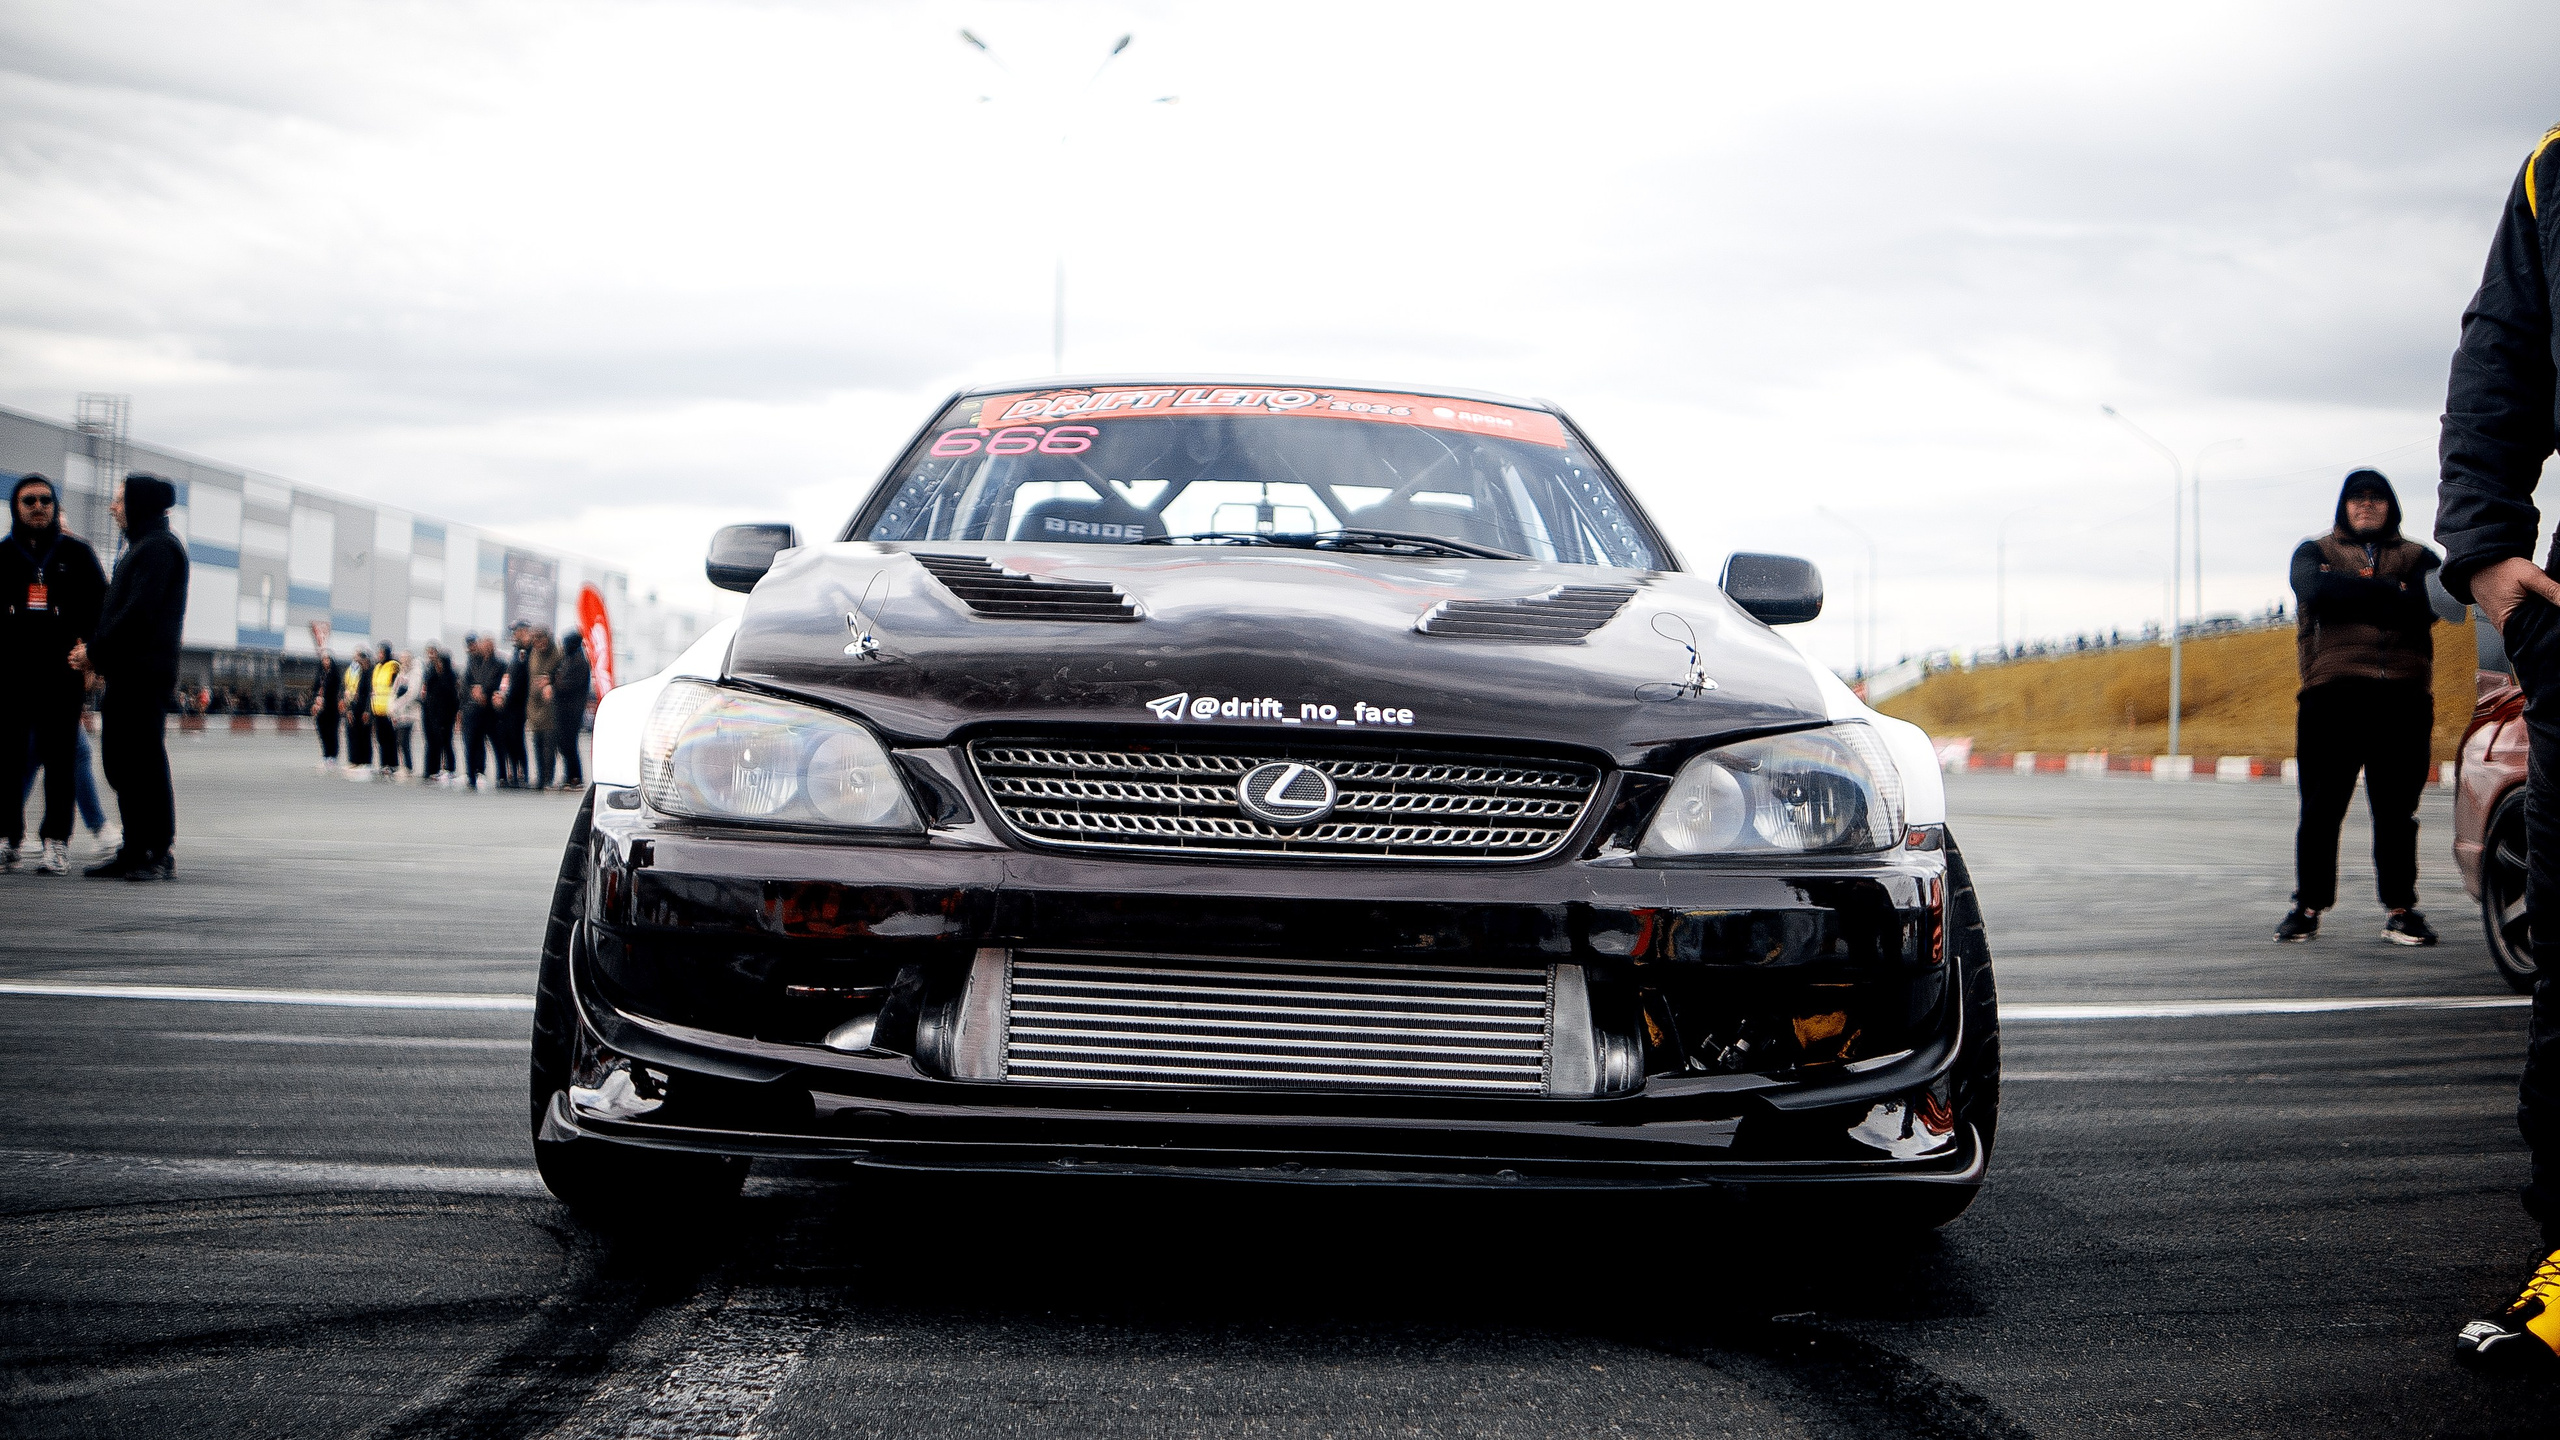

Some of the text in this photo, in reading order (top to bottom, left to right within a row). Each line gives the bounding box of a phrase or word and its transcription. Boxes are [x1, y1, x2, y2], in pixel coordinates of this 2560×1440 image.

[1000, 389, 1177, 419] DRIFT
[1171, 388, 1319, 412] LETO
[1328, 401, 1412, 416] 2026
[930, 425, 1099, 457] 666
[1044, 517, 1145, 539] BRIDE
[1190, 697, 1415, 726] @drift_no_face
